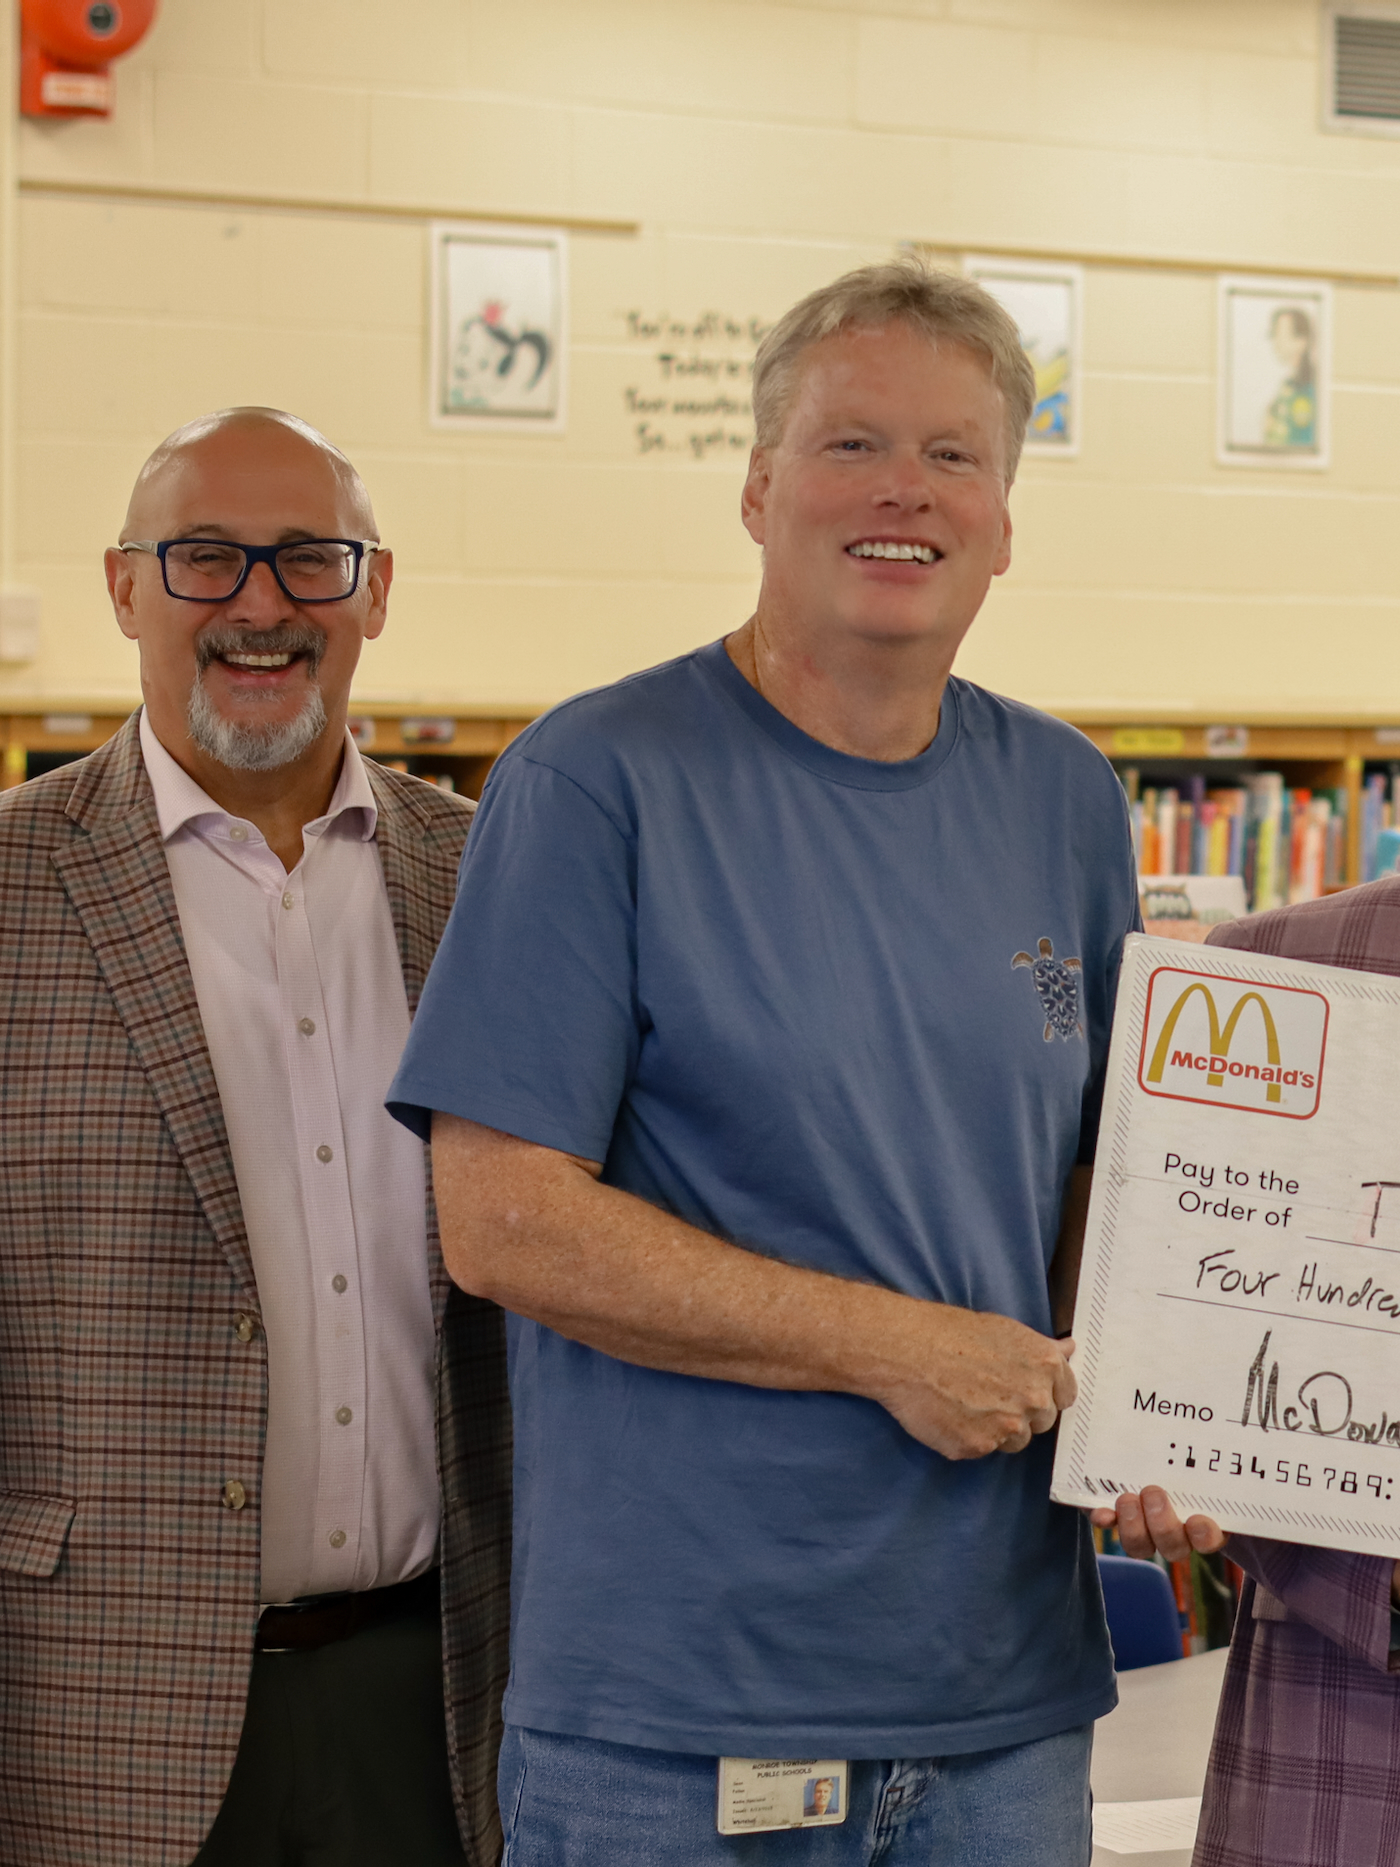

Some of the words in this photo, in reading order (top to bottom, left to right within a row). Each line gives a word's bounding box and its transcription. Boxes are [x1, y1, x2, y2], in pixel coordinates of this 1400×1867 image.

[1169, 1050, 1316, 1090] McDonald's
[1164, 1153, 1215, 1188] Pay
[1224, 1164, 1250, 1187] to
[1258, 1170, 1300, 1196] the
[1178, 1190, 1259, 1224] Order
[1266, 1207, 1293, 1229] of
[1196, 1249, 1281, 1298] Four
[1132, 1388, 1214, 1423] Memo
[752, 1762, 780, 1770] MONROE
[782, 1768, 812, 1776] SCHOOLS
